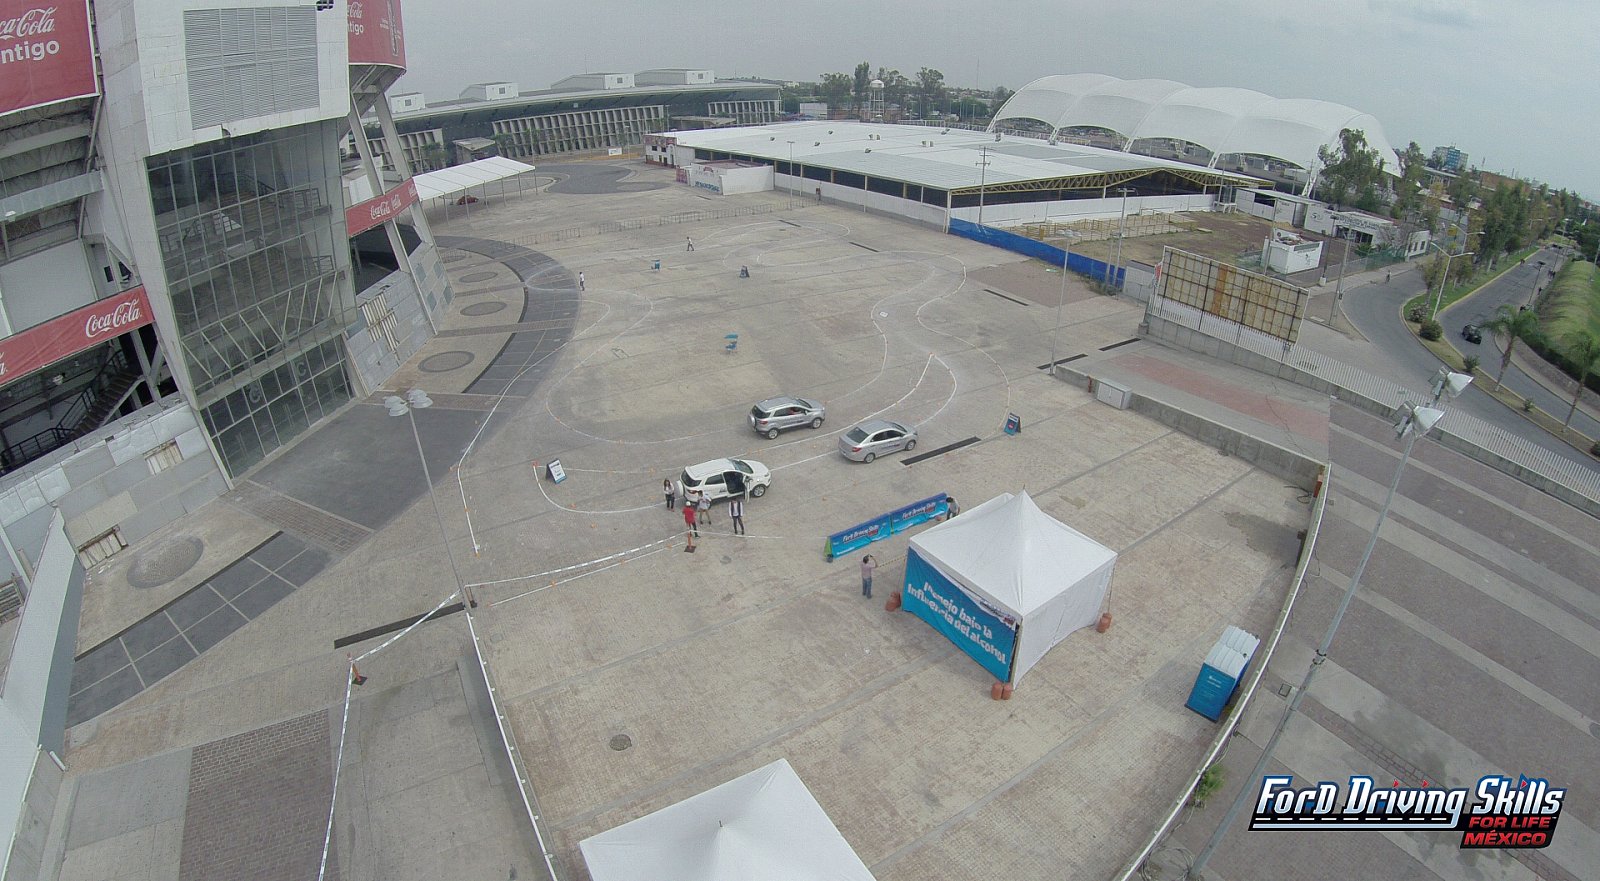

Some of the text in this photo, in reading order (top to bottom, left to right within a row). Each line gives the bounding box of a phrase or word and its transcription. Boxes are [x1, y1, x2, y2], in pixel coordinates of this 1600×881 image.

[959, 607, 982, 631] bajo
[983, 624, 992, 639] la
[970, 631, 1006, 665] alcohol
